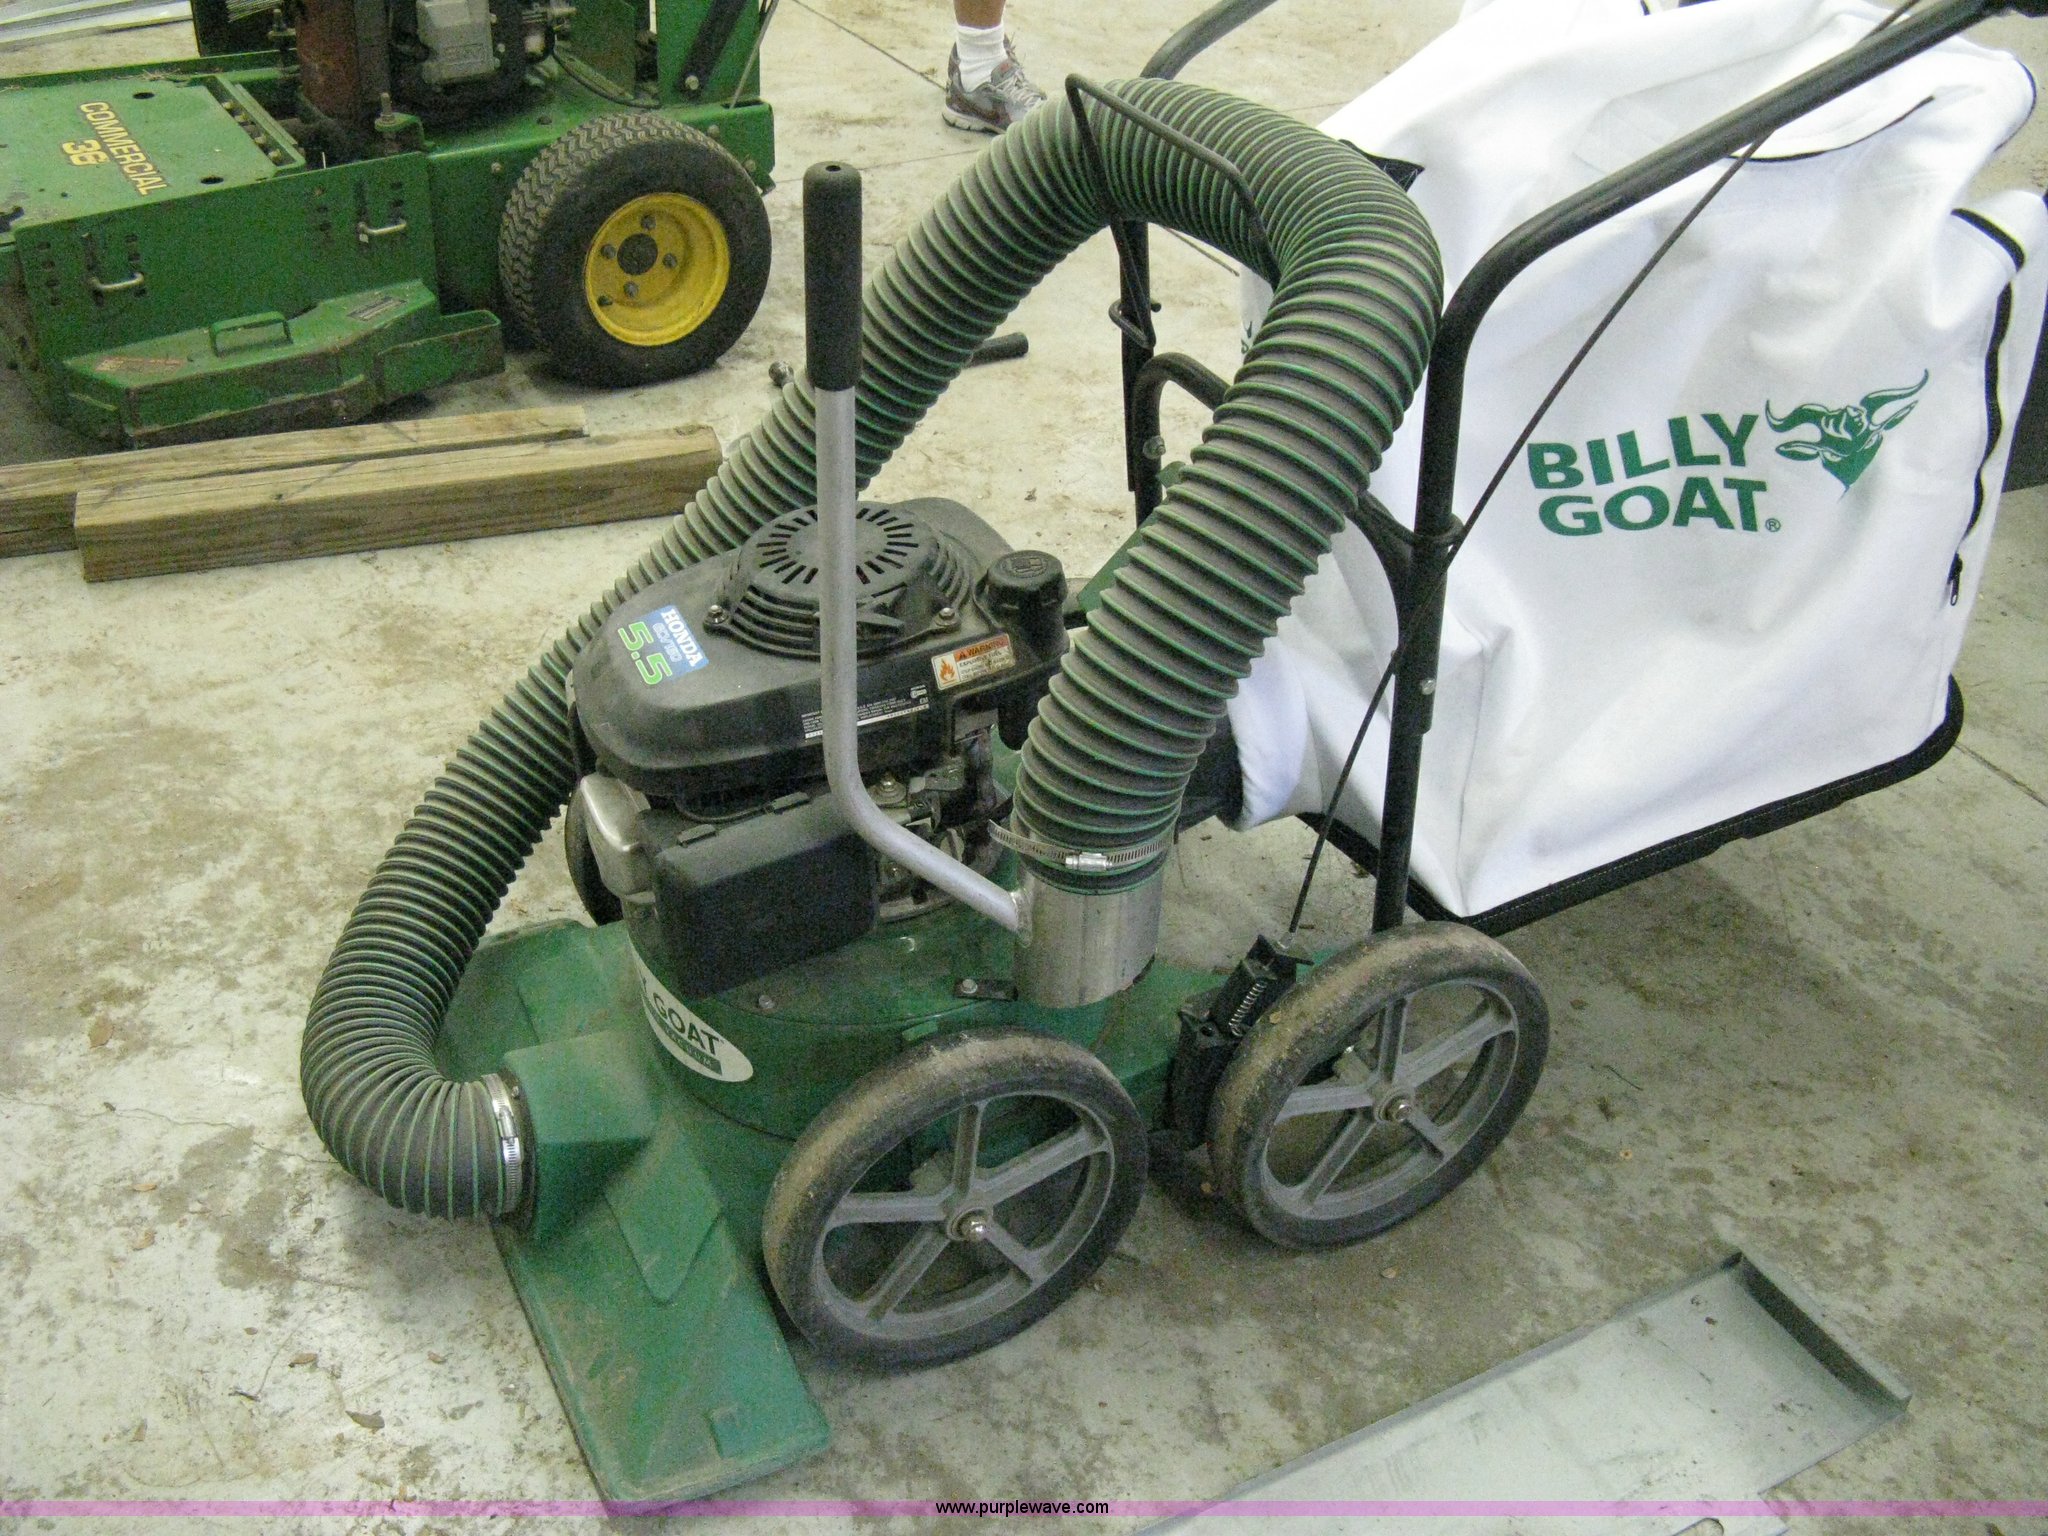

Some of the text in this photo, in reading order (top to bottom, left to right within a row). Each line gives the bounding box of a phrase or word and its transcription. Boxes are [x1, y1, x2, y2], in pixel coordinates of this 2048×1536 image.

[61, 139, 110, 166] 36
[80, 101, 168, 196] COMMERCIAL
[1527, 413, 1759, 490] BILLY
[617, 621, 673, 685] 5.5
[660, 608, 704, 667] HONDA
[652, 991, 720, 1056] GOAT
